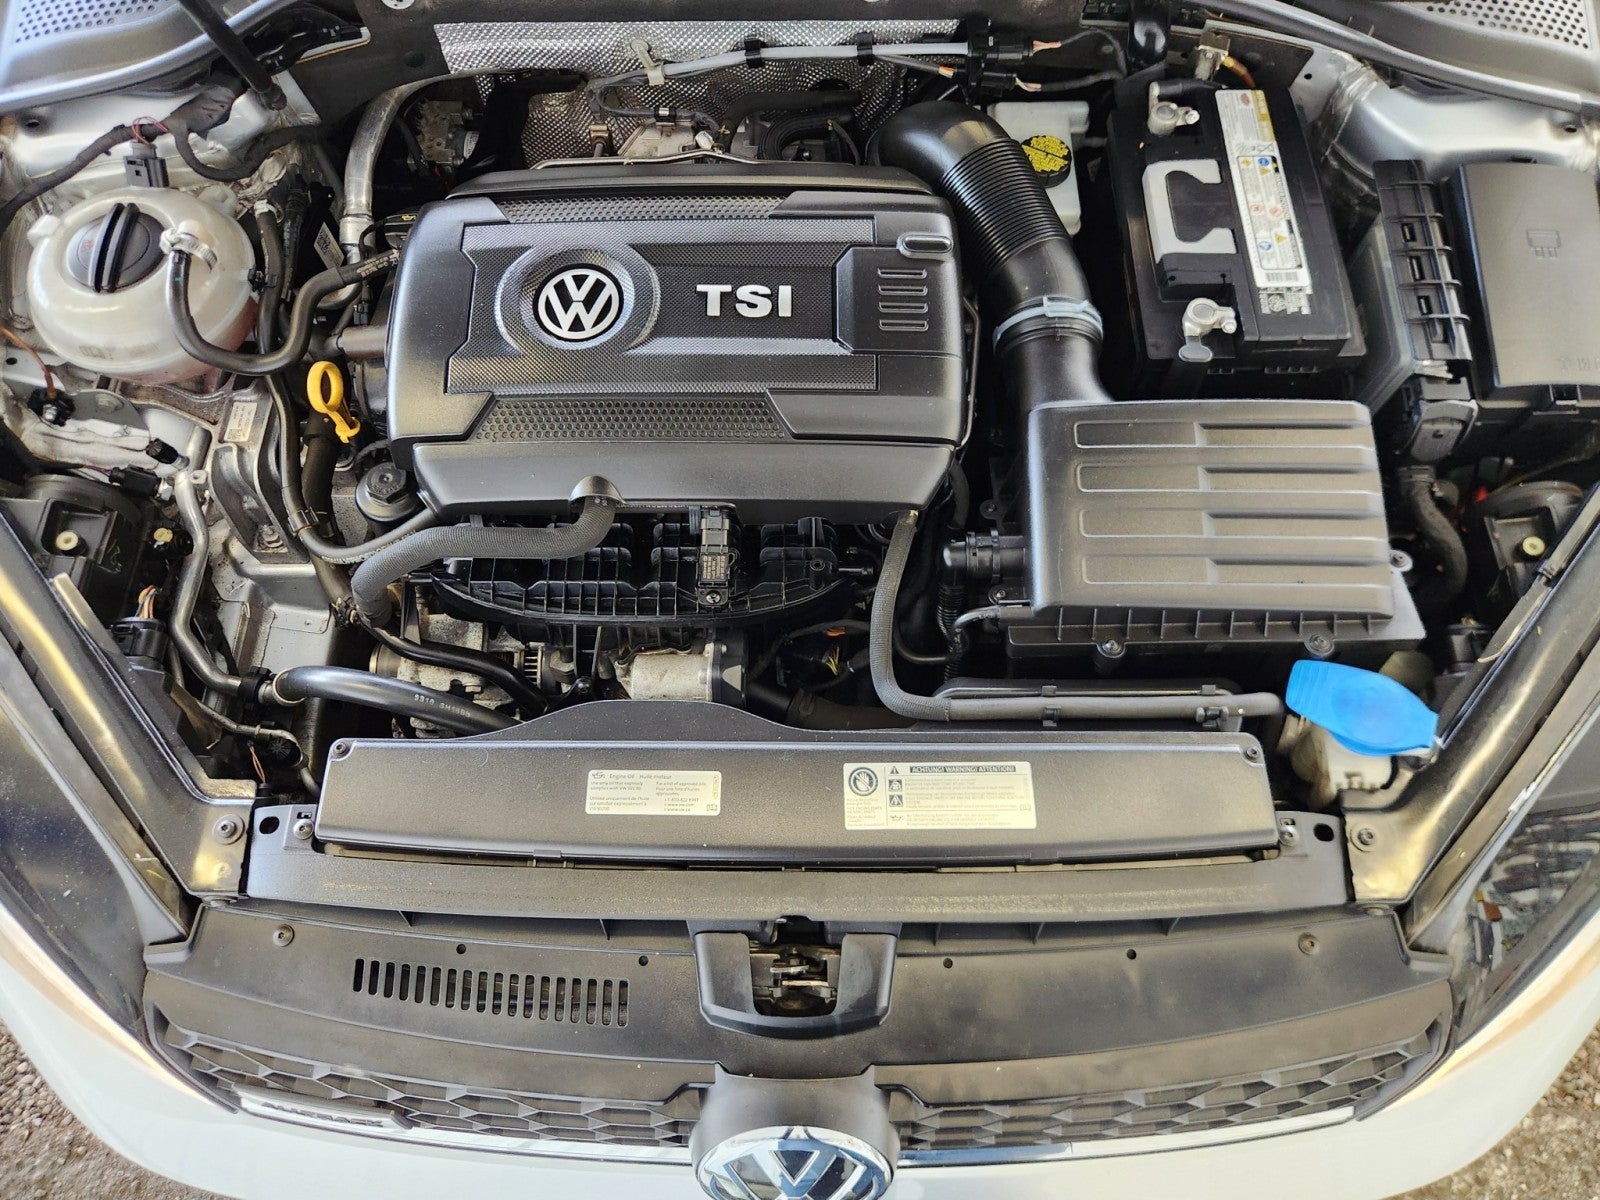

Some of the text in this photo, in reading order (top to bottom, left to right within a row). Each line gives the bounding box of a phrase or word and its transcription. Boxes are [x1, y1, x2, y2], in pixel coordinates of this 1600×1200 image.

[537, 268, 620, 340] VW
[697, 284, 793, 318] TSI
[978, 765, 1016, 773] ATTENTION!
